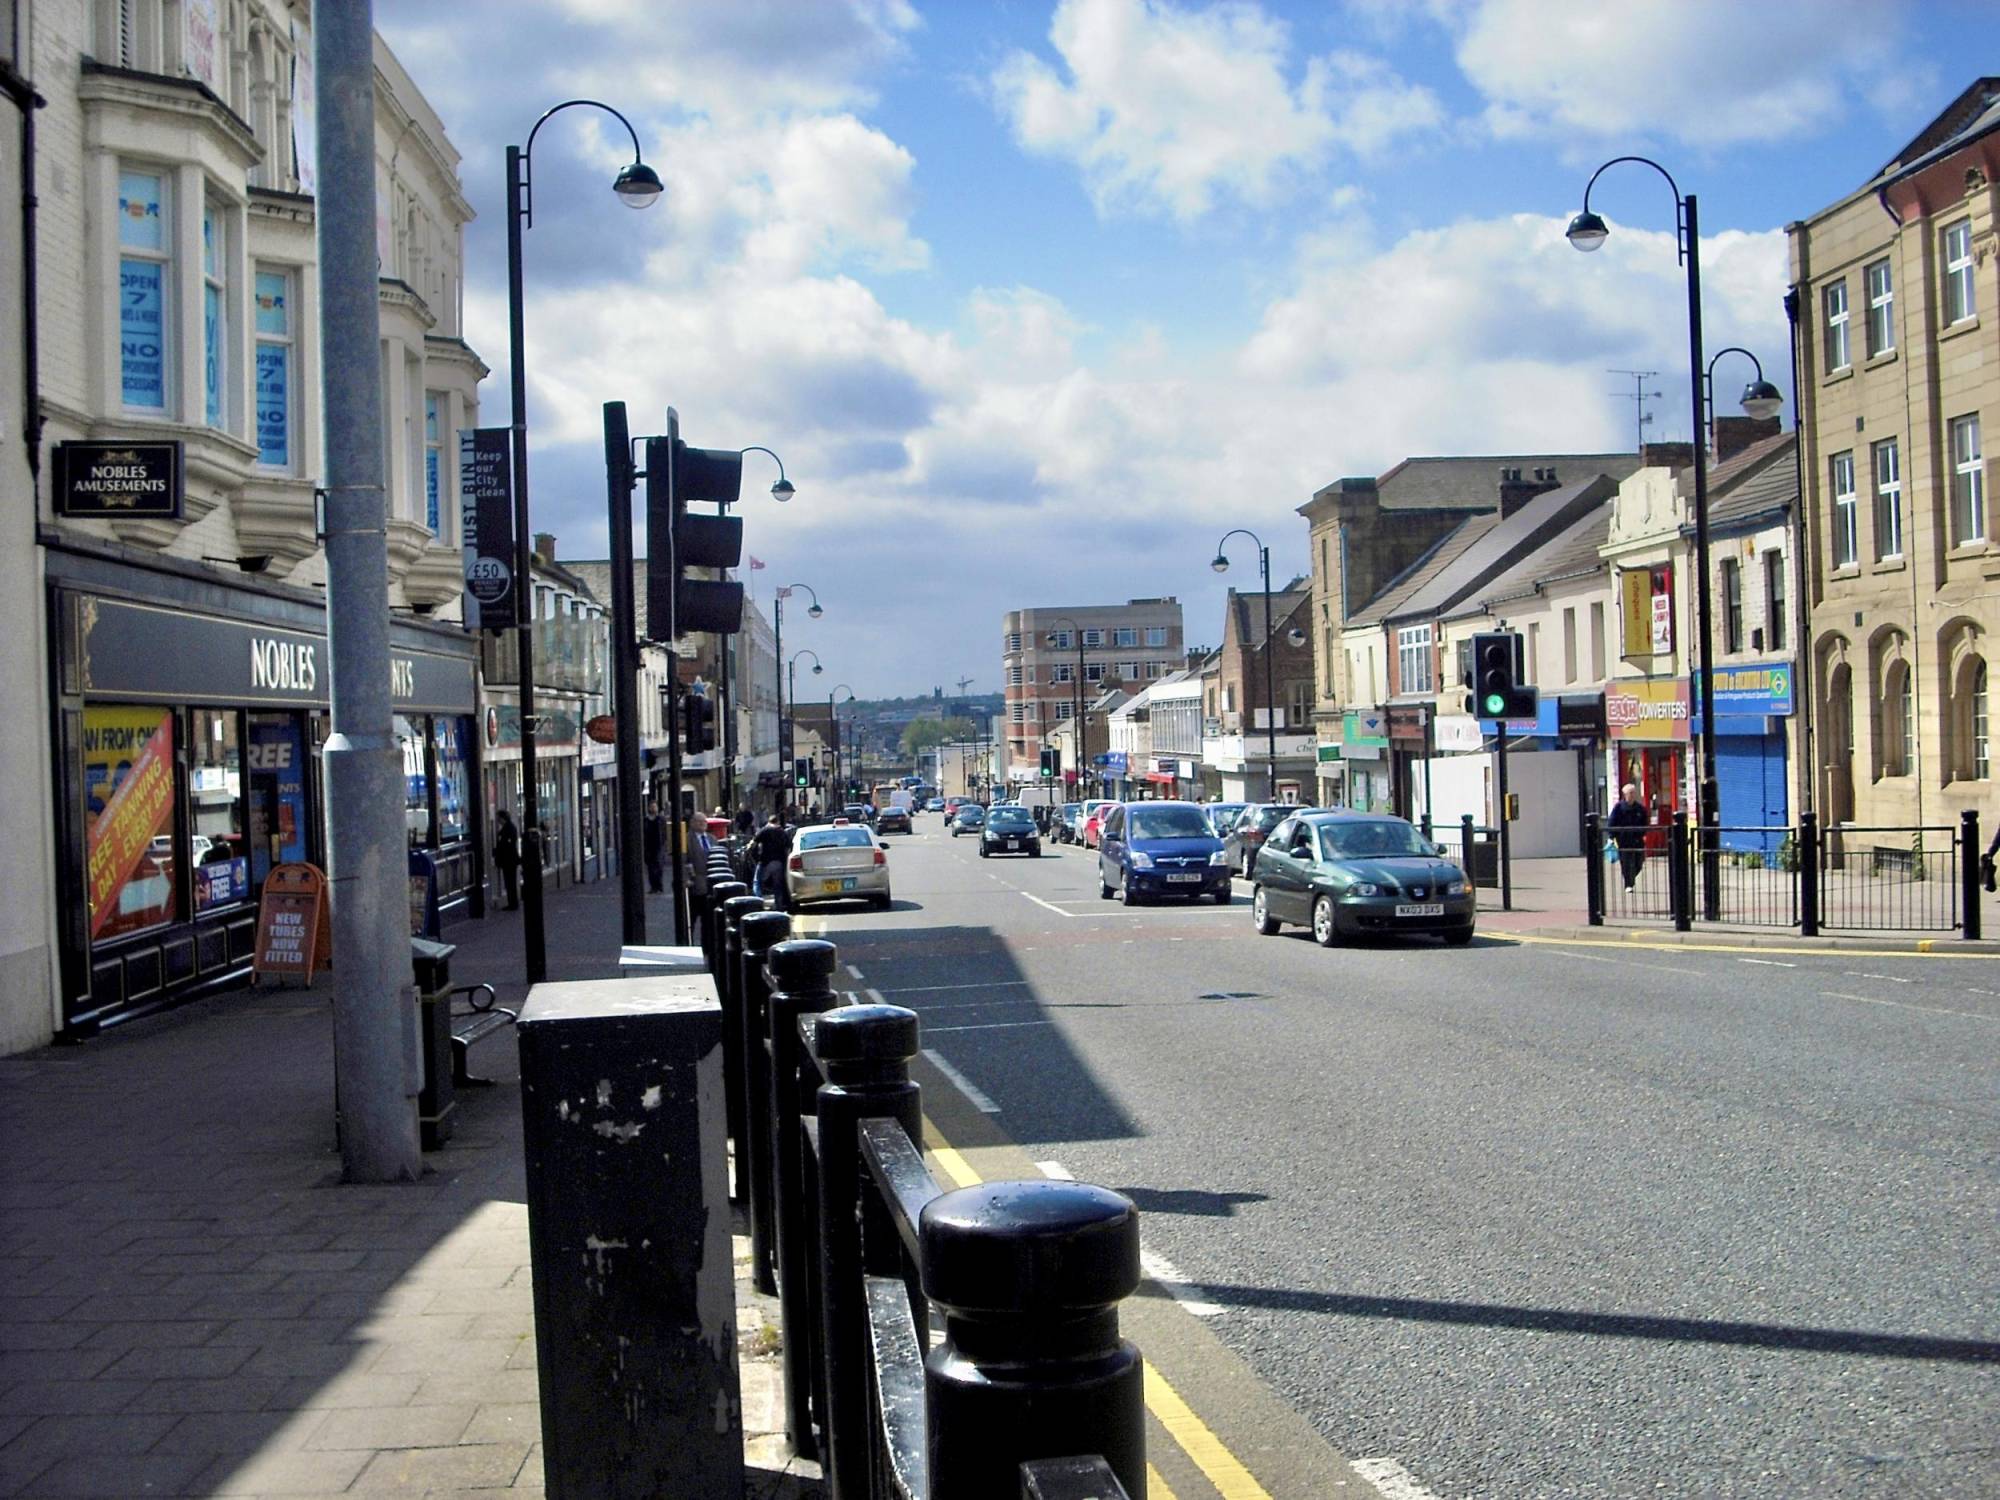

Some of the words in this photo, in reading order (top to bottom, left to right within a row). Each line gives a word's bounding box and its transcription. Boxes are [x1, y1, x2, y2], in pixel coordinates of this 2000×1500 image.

[120, 273, 158, 290] OPEN
[128, 291, 147, 305] 7
[121, 343, 159, 358] NO
[461, 437, 476, 453] IT
[476, 451, 502, 462] Keep
[91, 465, 148, 479] NOBLES
[476, 464, 493, 473] our
[461, 463, 477, 494] BIN
[476, 475, 497, 486] City
[74, 480, 166, 492] AMUSEMENTS
[476, 487, 505, 497] clean
[463, 504, 478, 549] JUST
[473, 563, 499, 578] £50
[251, 637, 316, 692] NOBLES
[1639, 702, 1687, 720] CONVERTERS
[102, 728, 133, 751] FROM
[113, 755, 161, 838] TANNING
[98, 859, 118, 901] DAY
[123, 805, 152, 859] EVERY
[275, 913, 302, 925] NEW
[269, 925, 306, 937] TUBES
[271, 938, 301, 950] NOW
[264, 951, 304, 963] FITTED
